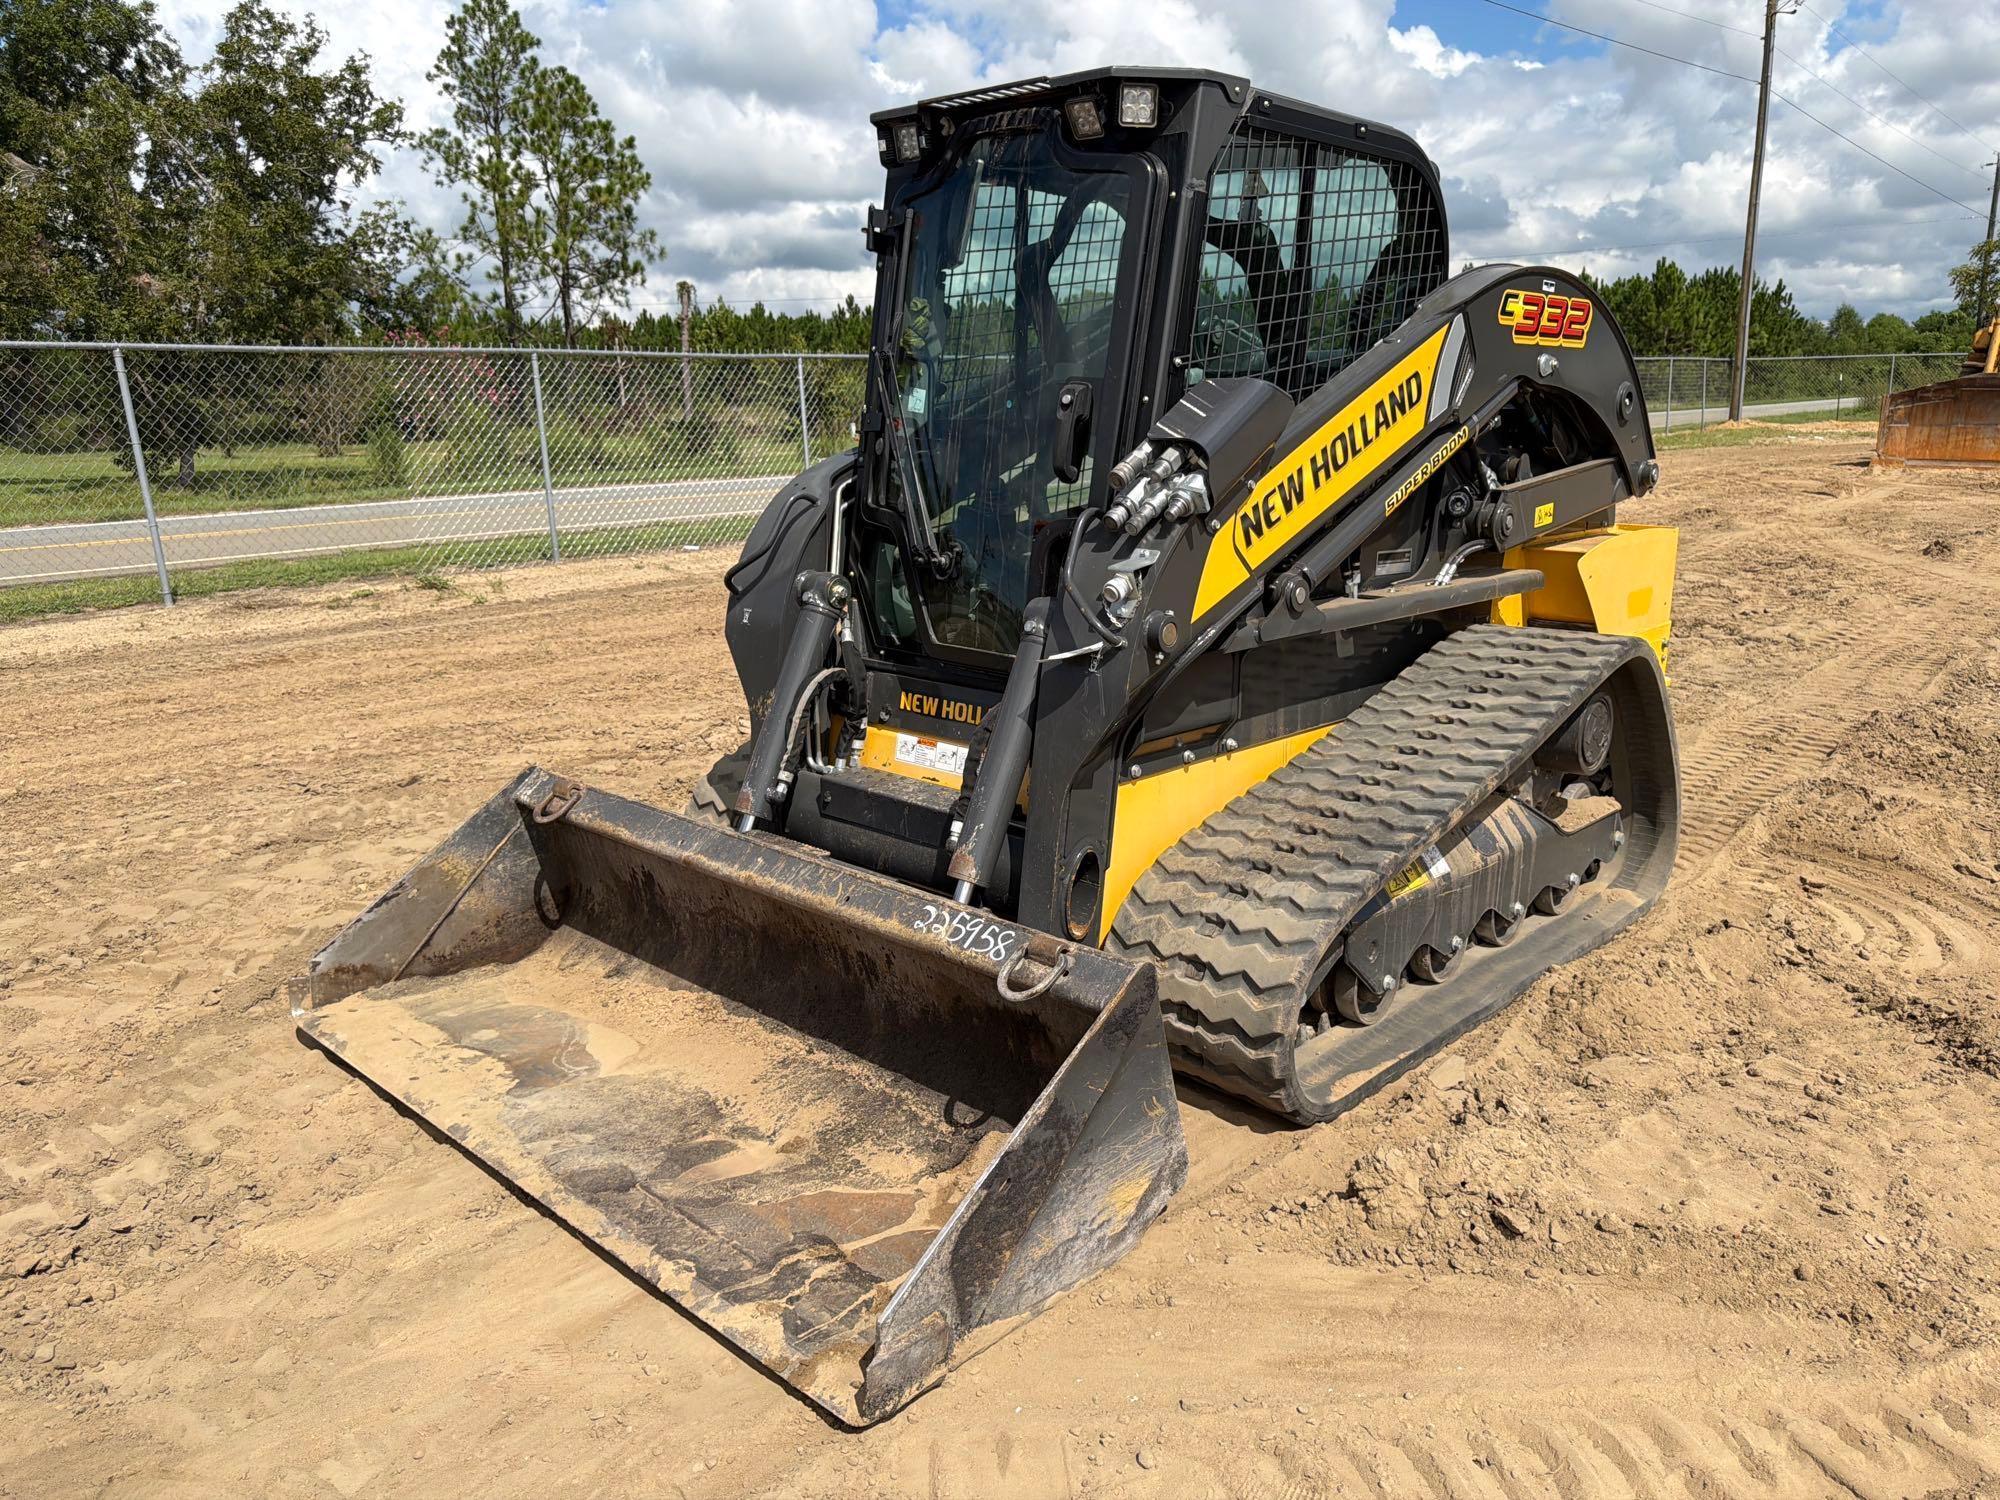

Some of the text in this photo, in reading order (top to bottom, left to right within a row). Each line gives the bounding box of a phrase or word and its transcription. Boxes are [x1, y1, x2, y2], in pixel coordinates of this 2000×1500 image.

[1240, 370, 1422, 549] NEW HOLLAND
[1386, 426, 1468, 513] SUPER BOOM
[899, 691, 982, 726] NEW HOLL
[913, 904, 1016, 961] 225958
